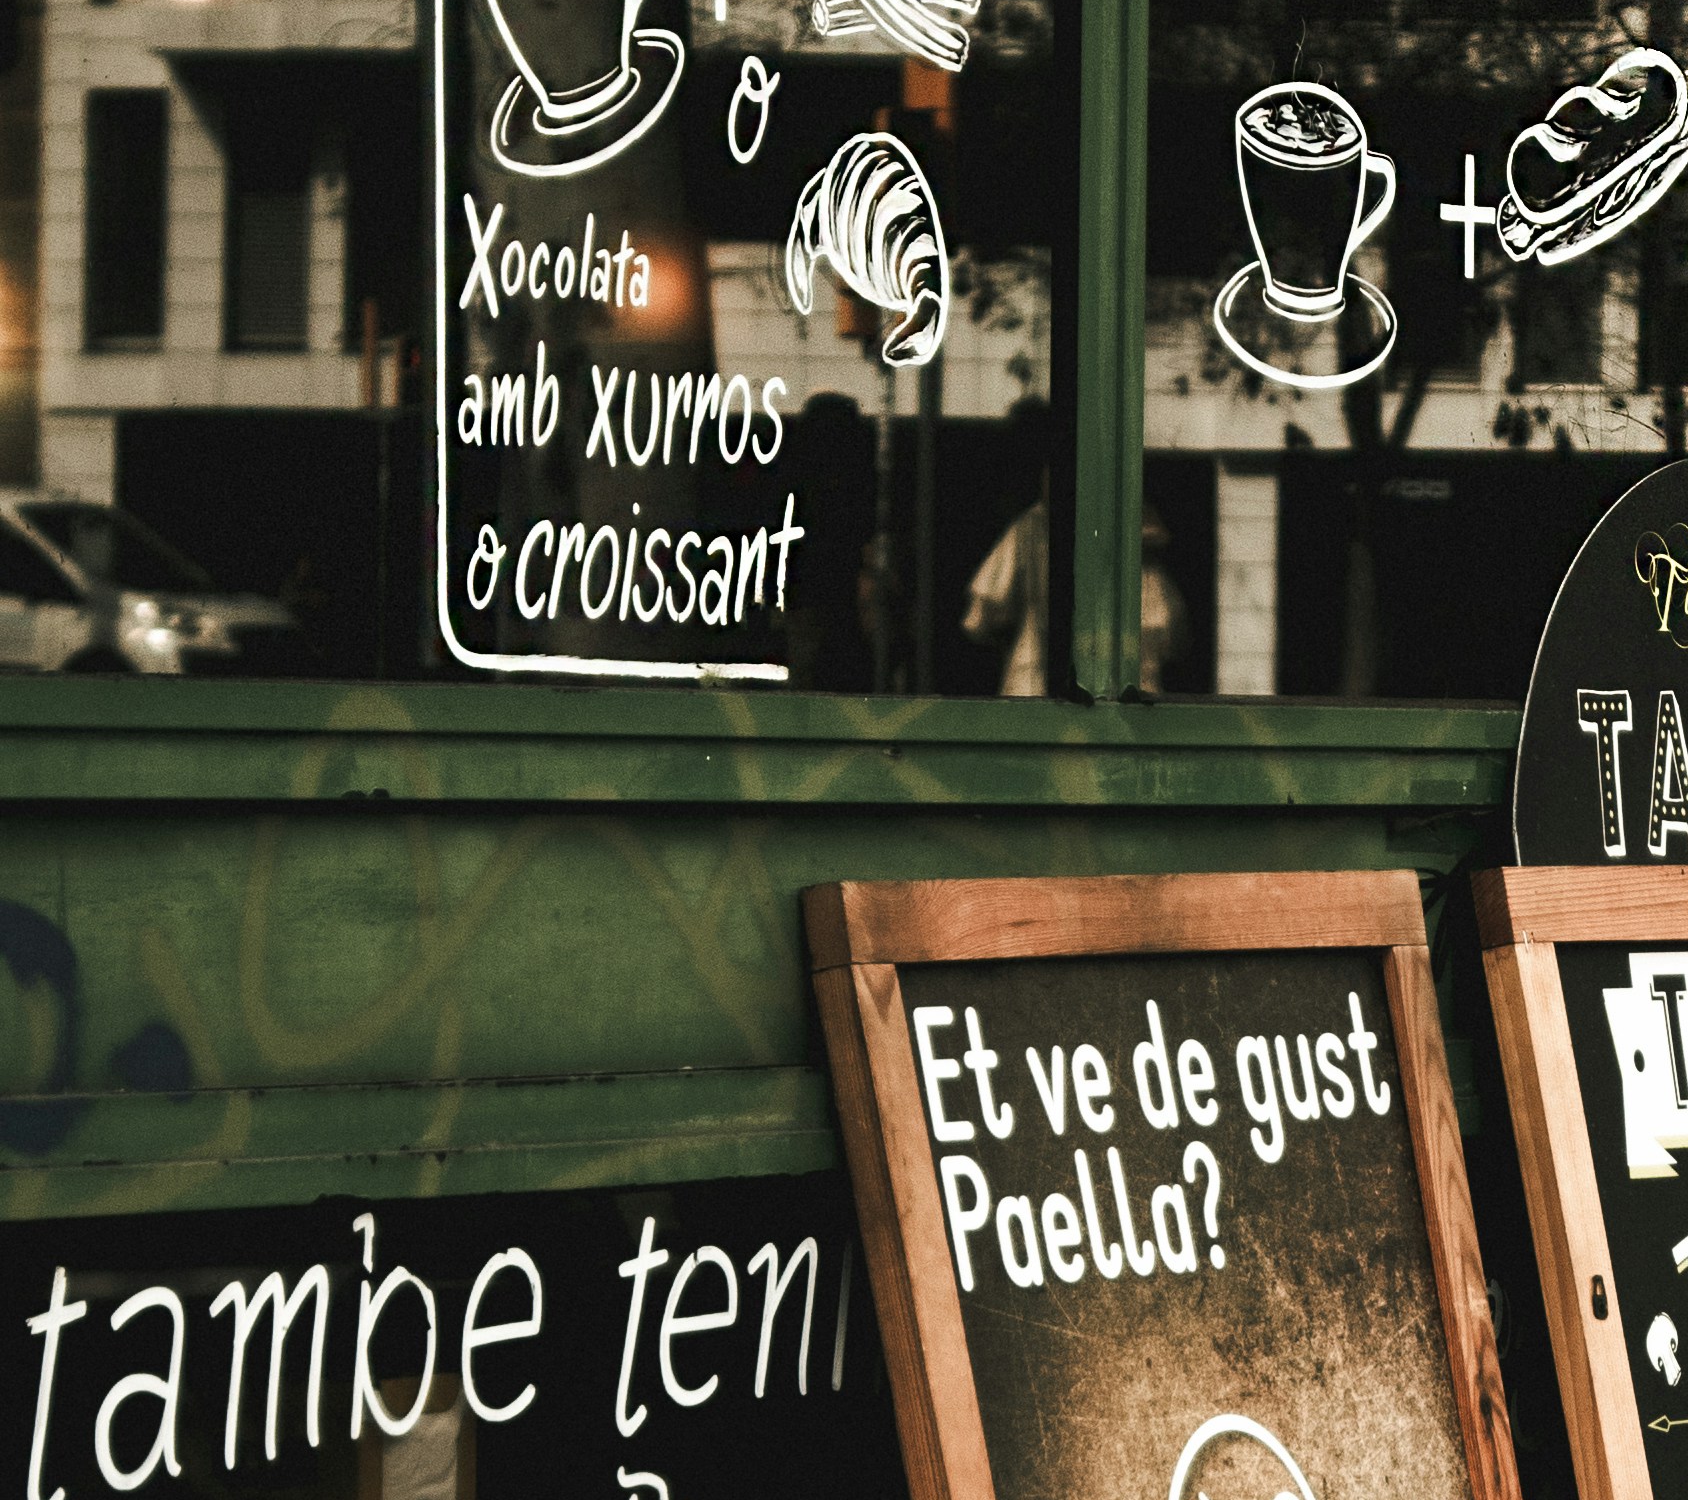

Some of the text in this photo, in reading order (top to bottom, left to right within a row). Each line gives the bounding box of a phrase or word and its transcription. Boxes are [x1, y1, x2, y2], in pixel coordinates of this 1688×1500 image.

[459, 192, 651, 319] Xocolata
[458, 340, 559, 447] amb
[516, 493, 806, 628] croissant
[912, 992, 1391, 1164] Et ve de gust
[939, 1140, 1227, 1293] Paella?
